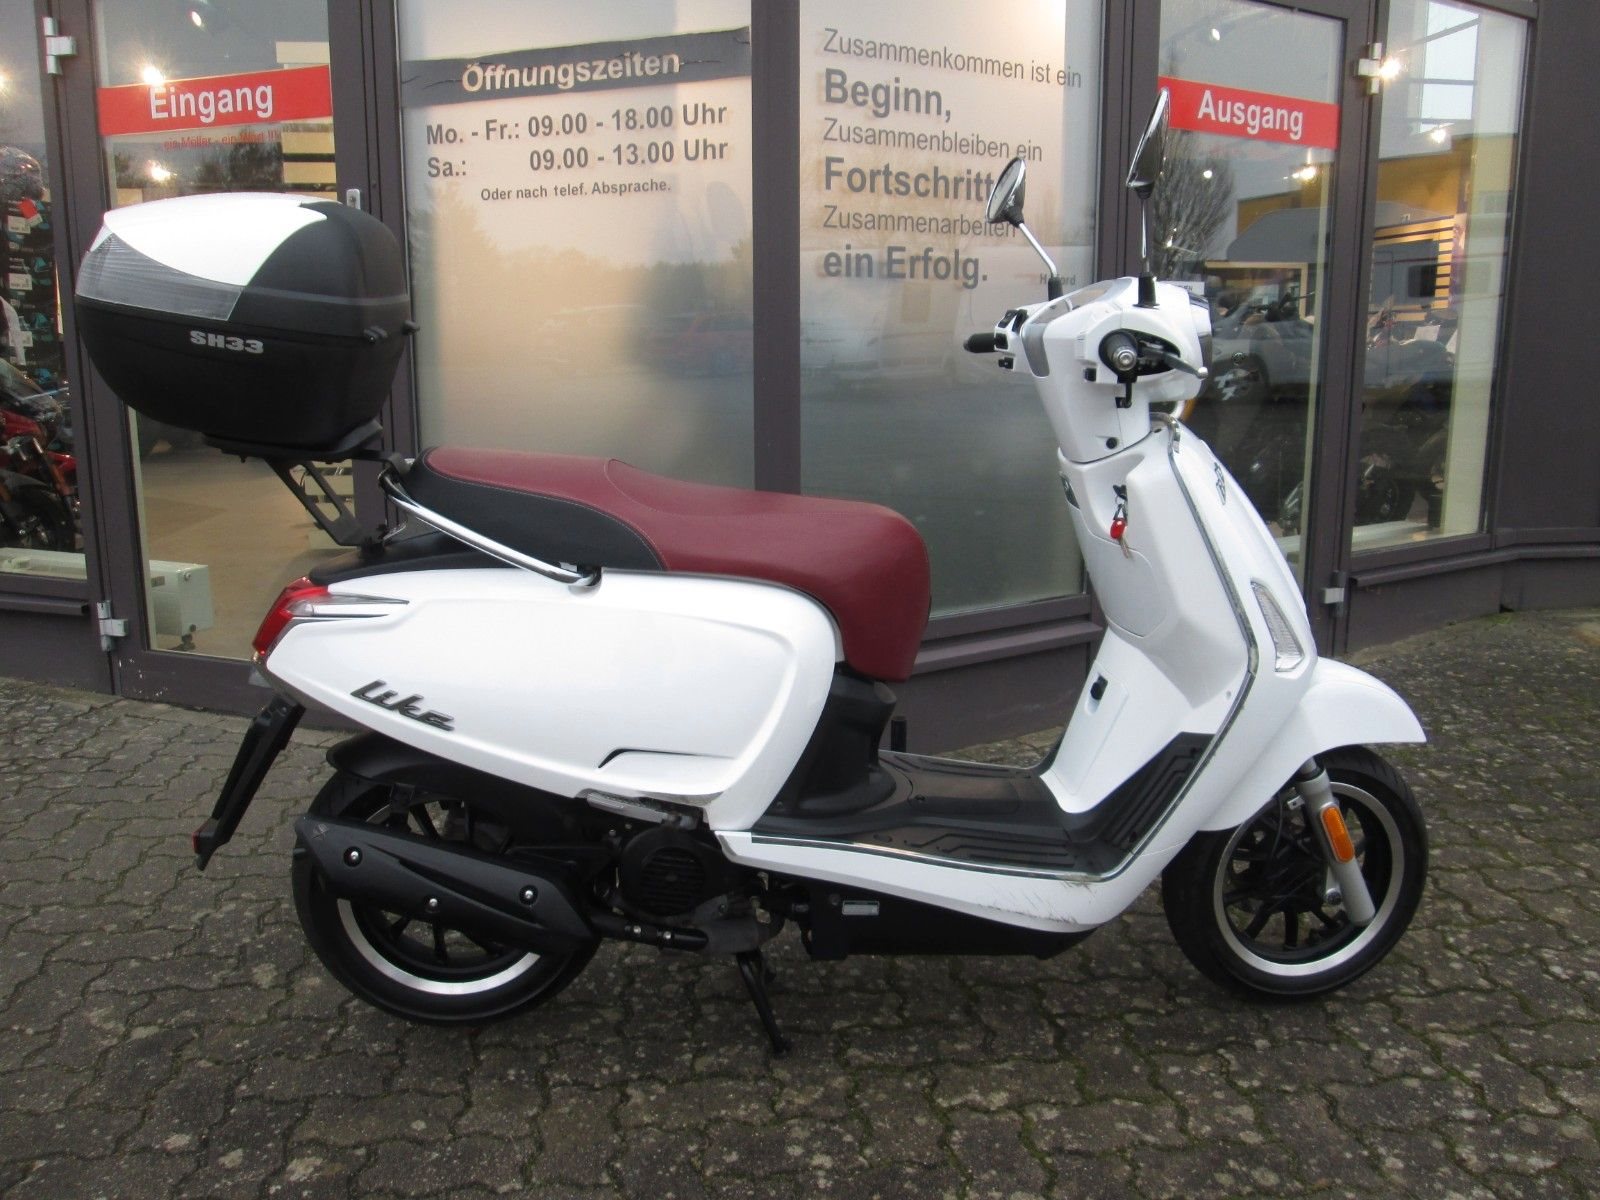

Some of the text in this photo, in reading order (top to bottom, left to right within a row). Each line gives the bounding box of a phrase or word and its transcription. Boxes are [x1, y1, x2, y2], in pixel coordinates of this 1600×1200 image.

[461, 51, 681, 92] Öffnungszeiten
[823, 28, 1082, 88] Zusammenkommen ist ein
[150, 84, 273, 123] Eingang
[824, 68, 952, 122] Beginn,
[1197, 89, 1303, 140] Ausgang
[426, 123, 464, 145] Mo.
[485, 118, 520, 141] Fr.:
[528, 112, 588, 137] 09.00
[611, 105, 673, 131] 18.00
[682, 103, 727, 126] Uhr
[823, 117, 1042, 161] Zusammenbleiben ein
[427, 156, 467, 178] Sa.:
[529, 147, 589, 171] 09.00
[612, 140, 675, 166] 13.00
[684, 138, 729, 161] Uhr
[824, 155, 994, 202] Fortschritt
[481, 178, 671, 201] Oder nach telef. Absprache.
[823, 204, 1016, 238] Zusammenarbeiten
[823, 244, 988, 290] ein Erfolg.
[189, 330, 264, 354] SH33
